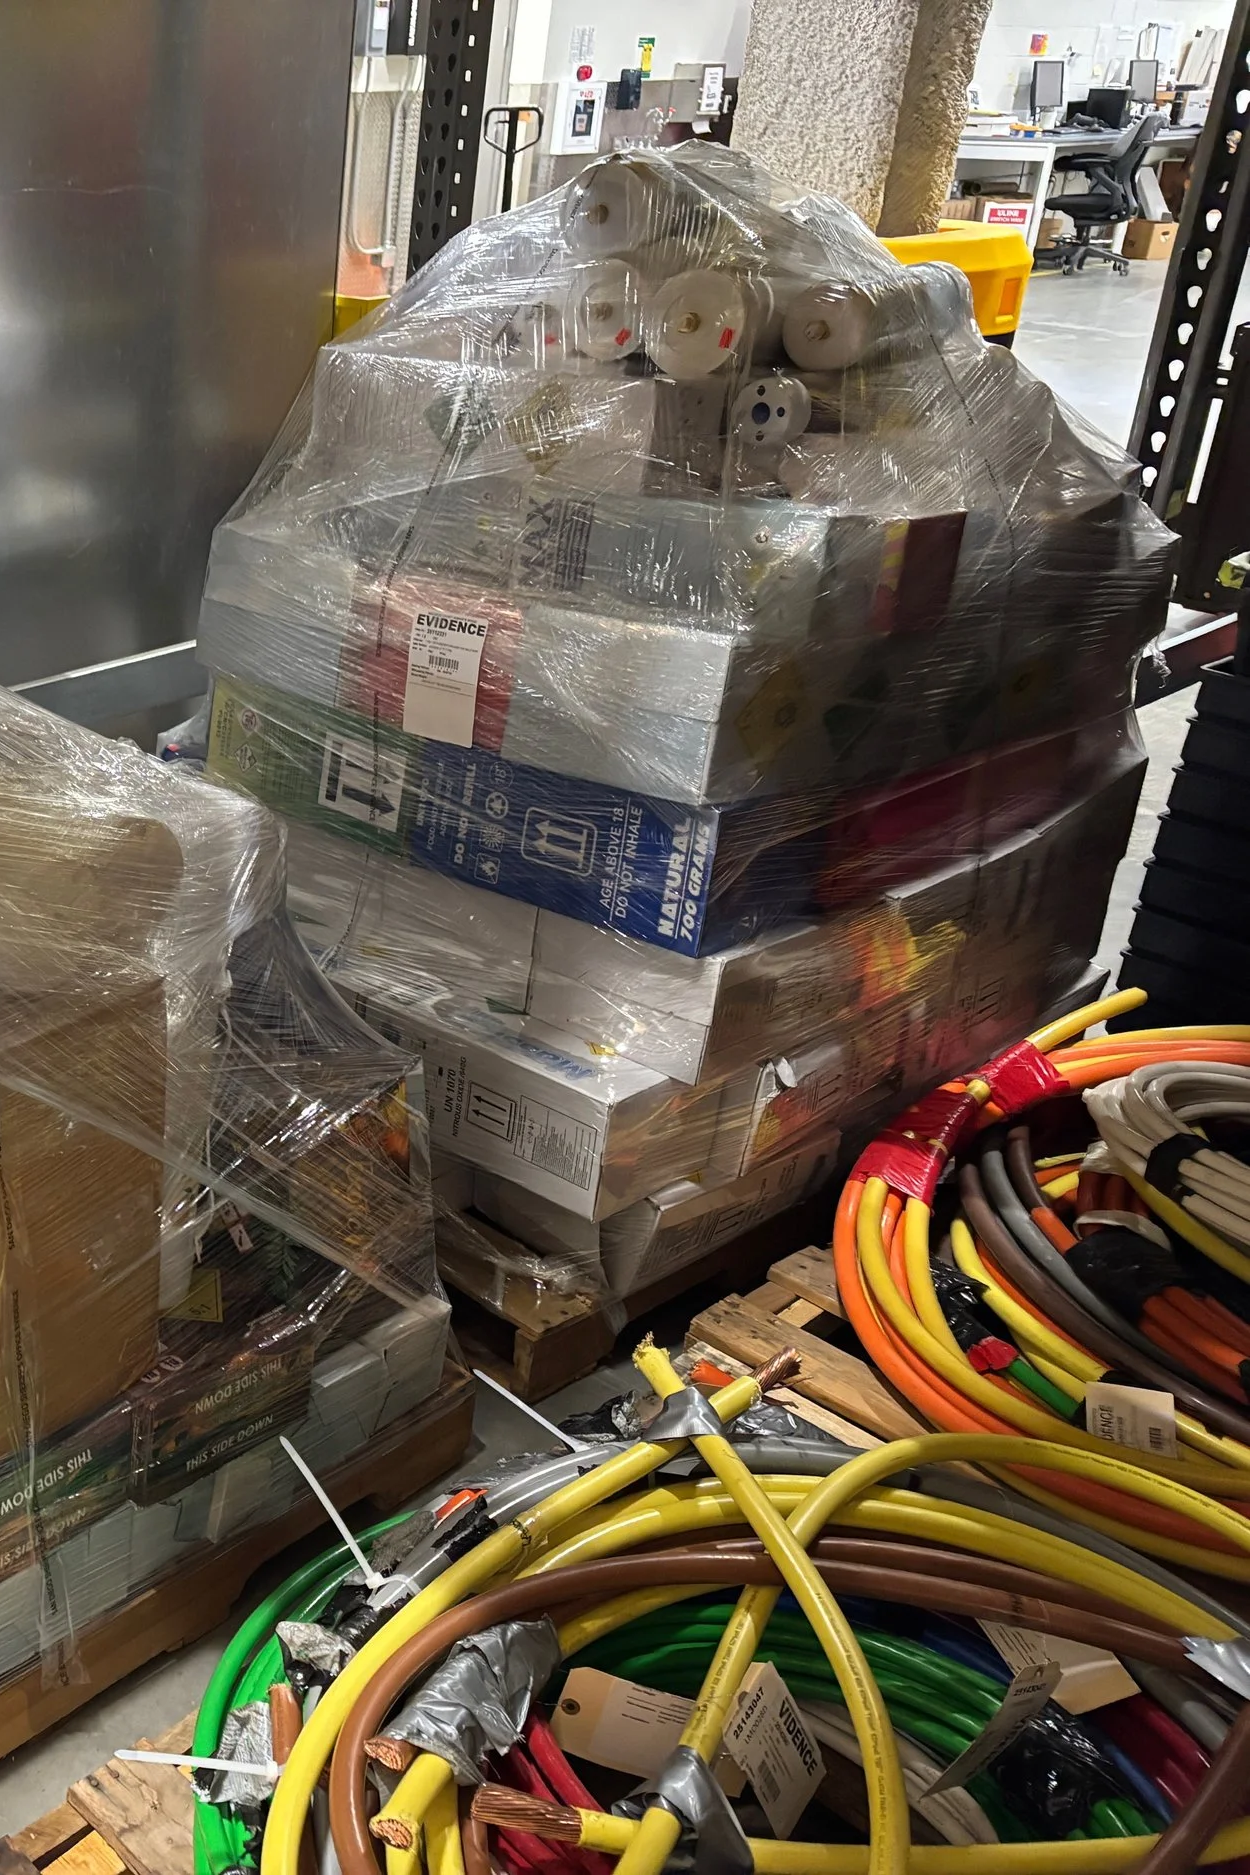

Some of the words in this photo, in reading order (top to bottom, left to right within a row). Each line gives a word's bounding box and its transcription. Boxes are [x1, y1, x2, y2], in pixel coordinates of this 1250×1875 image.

[417, 613, 487, 637] EVIDENCE
[456, 810, 469, 839] NOT
[613, 806, 625, 823] 18
[624, 806, 643, 859] INHALE
[454, 842, 465, 865] DO
[604, 826, 622, 876] ABOVE
[688, 821, 710, 897] GRAMS
[617, 862, 635, 893] NOT
[658, 817, 691, 937] NATURAL
[599, 878, 614, 909] AGE
[614, 896, 629, 919] DO
[680, 899, 698, 942] 700
[446, 1068, 456, 1094] 1070
[444, 1095, 454, 1113] UN
[452, 1103, 462, 1138] NITROUS
[235, 1371, 258, 1393] SIDE
[261, 1358, 282, 1378] THIS
[194, 1384, 231, 1415] DOWN
[186, 1450, 208, 1472] THIS
[211, 1436, 235, 1457] SIDE
[237, 1414, 274, 1441] DOWN
[67, 1449, 93, 1473] THIS
[36, 1466, 64, 1492] SIDE
[46, 1507, 87, 1540] DOWN
[733, 1686, 765, 1740] 25143047
[779, 1700, 818, 1777] VIDENCE
